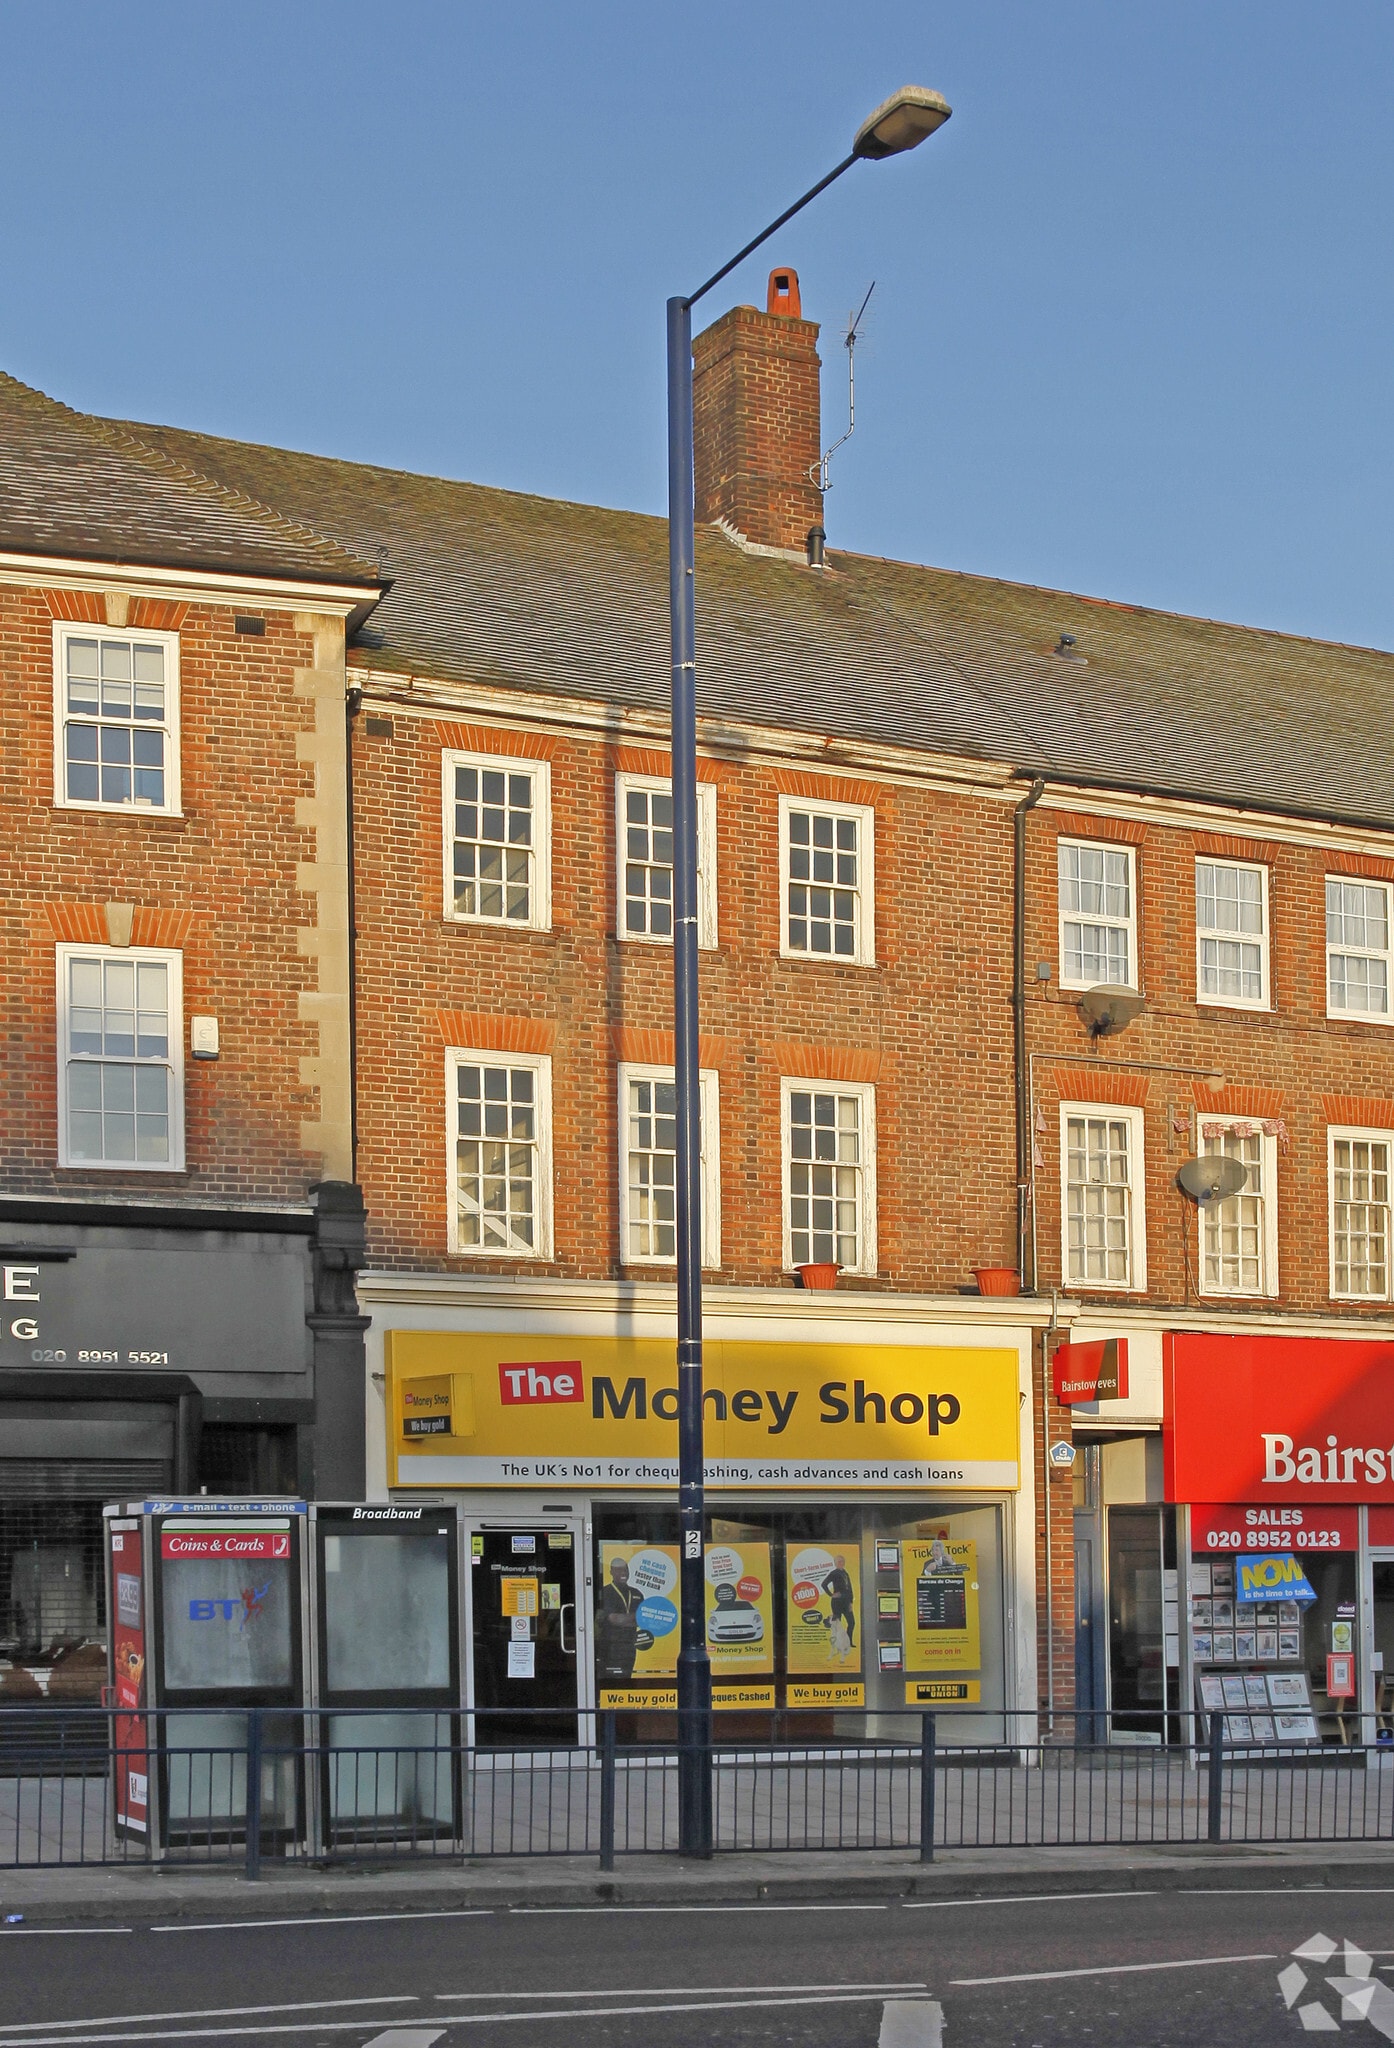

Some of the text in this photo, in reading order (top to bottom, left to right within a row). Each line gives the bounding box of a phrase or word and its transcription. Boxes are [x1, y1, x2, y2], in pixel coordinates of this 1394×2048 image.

[0, 1317, 39, 1340] G
[31, 1349, 169, 1365] 020 8951 5521
[1061, 1378, 1117, 1393] Bairstow eves
[413, 1395, 433, 1408] Money
[434, 1393, 449, 1407] Shop
[504, 1367, 961, 1436] The Money Shop
[411, 1418, 445, 1433] We buy gold
[501, 1463, 529, 1476] The
[573, 1464, 602, 1476] No1
[608, 1464, 630, 1477] for
[635, 1464, 680, 1482] chequ
[702, 1465, 753, 1481] ashing,
[757, 1465, 789, 1479] cash
[793, 1466, 858, 1480] advances
[862, 1467, 889, 1480] and
[893, 1467, 923, 1480] cash
[927, 1468, 964, 1480] loans
[182, 1503, 217, 1512] e-mail
[228, 1503, 250, 1512] text
[261, 1503, 296, 1512] phone
[352, 1507, 423, 1519] Broadband
[1245, 1509, 1304, 1526] SALES
[688, 1531, 699, 1544] 2
[1206, 1530, 1341, 1548] 020 8952 0123
[169, 1537, 265, 1552] Coins & Cards
[690, 1547, 697, 1556] 2
[501, 1565, 526, 1573] Money
[528, 1565, 547, 1573] Shop
[651, 1561, 667, 1571] cash
[652, 1574, 666, 1585] than
[1241, 1557, 1304, 1591] NOW
[646, 1581, 661, 1591] bank
[1245, 1591, 1252, 1599] is
[1252, 1590, 1265, 1598] the
[1265, 1590, 1284, 1598] time
[1284, 1589, 1293, 1597] to
[189, 1599, 240, 1621] BT
[954, 1647, 961, 1655] in
[607, 1693, 676, 1706] We buy gold
[711, 1692, 770, 1703] eques Cashed
[793, 1687, 859, 1699] We buy gold
